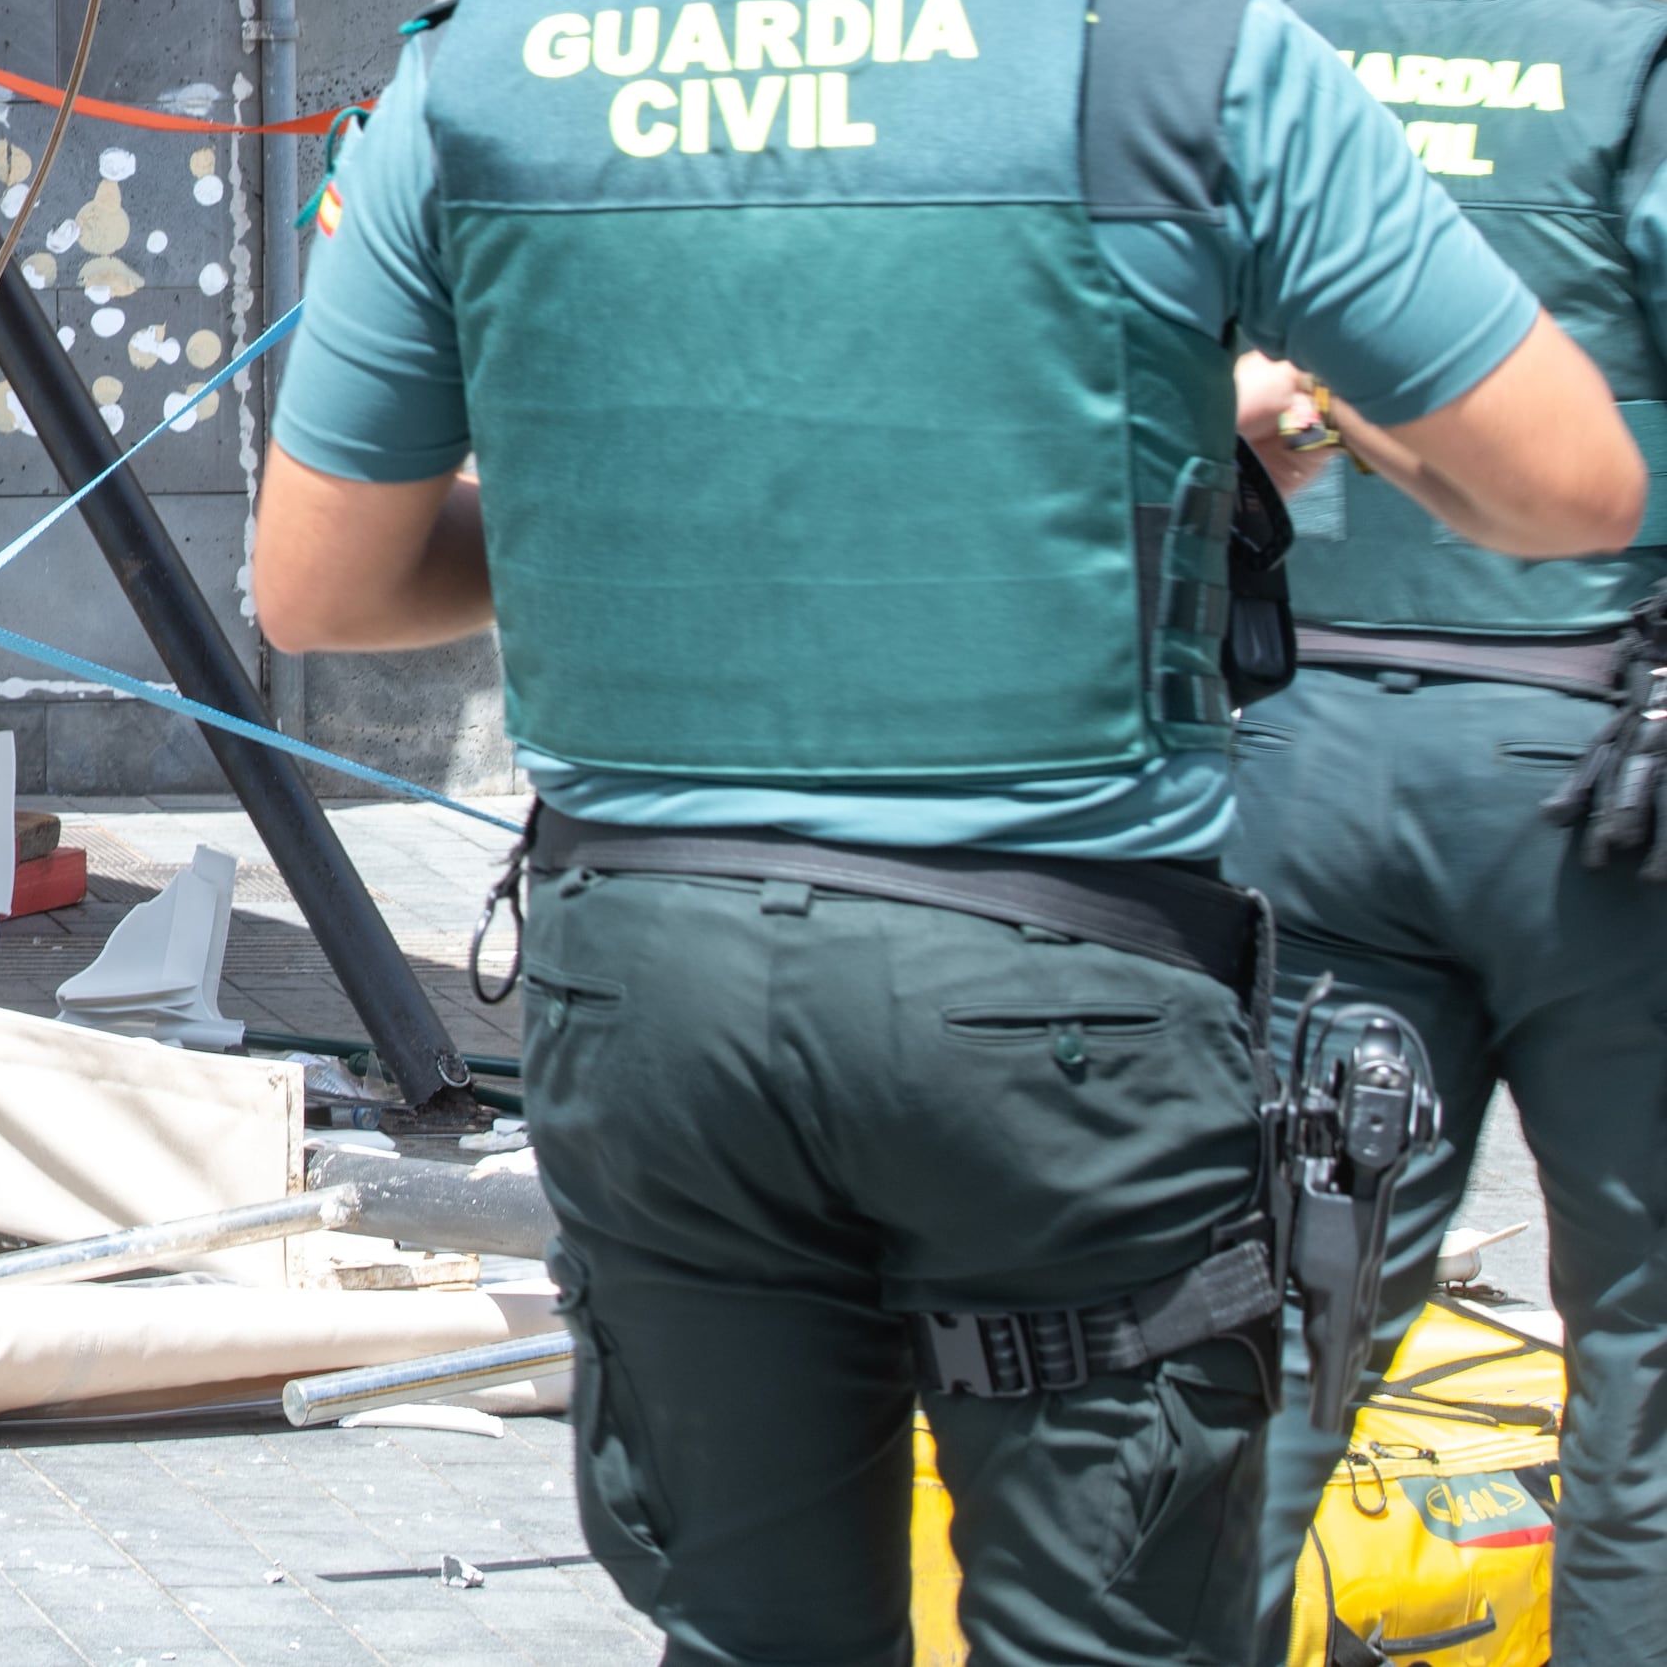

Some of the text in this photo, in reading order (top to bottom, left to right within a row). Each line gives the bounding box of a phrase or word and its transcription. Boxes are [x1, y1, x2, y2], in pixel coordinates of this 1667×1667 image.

[1336, 49, 1566, 112] ARDIA
[608, 71, 877, 158] CIVIL
[1398, 119, 1495, 177] VIL
